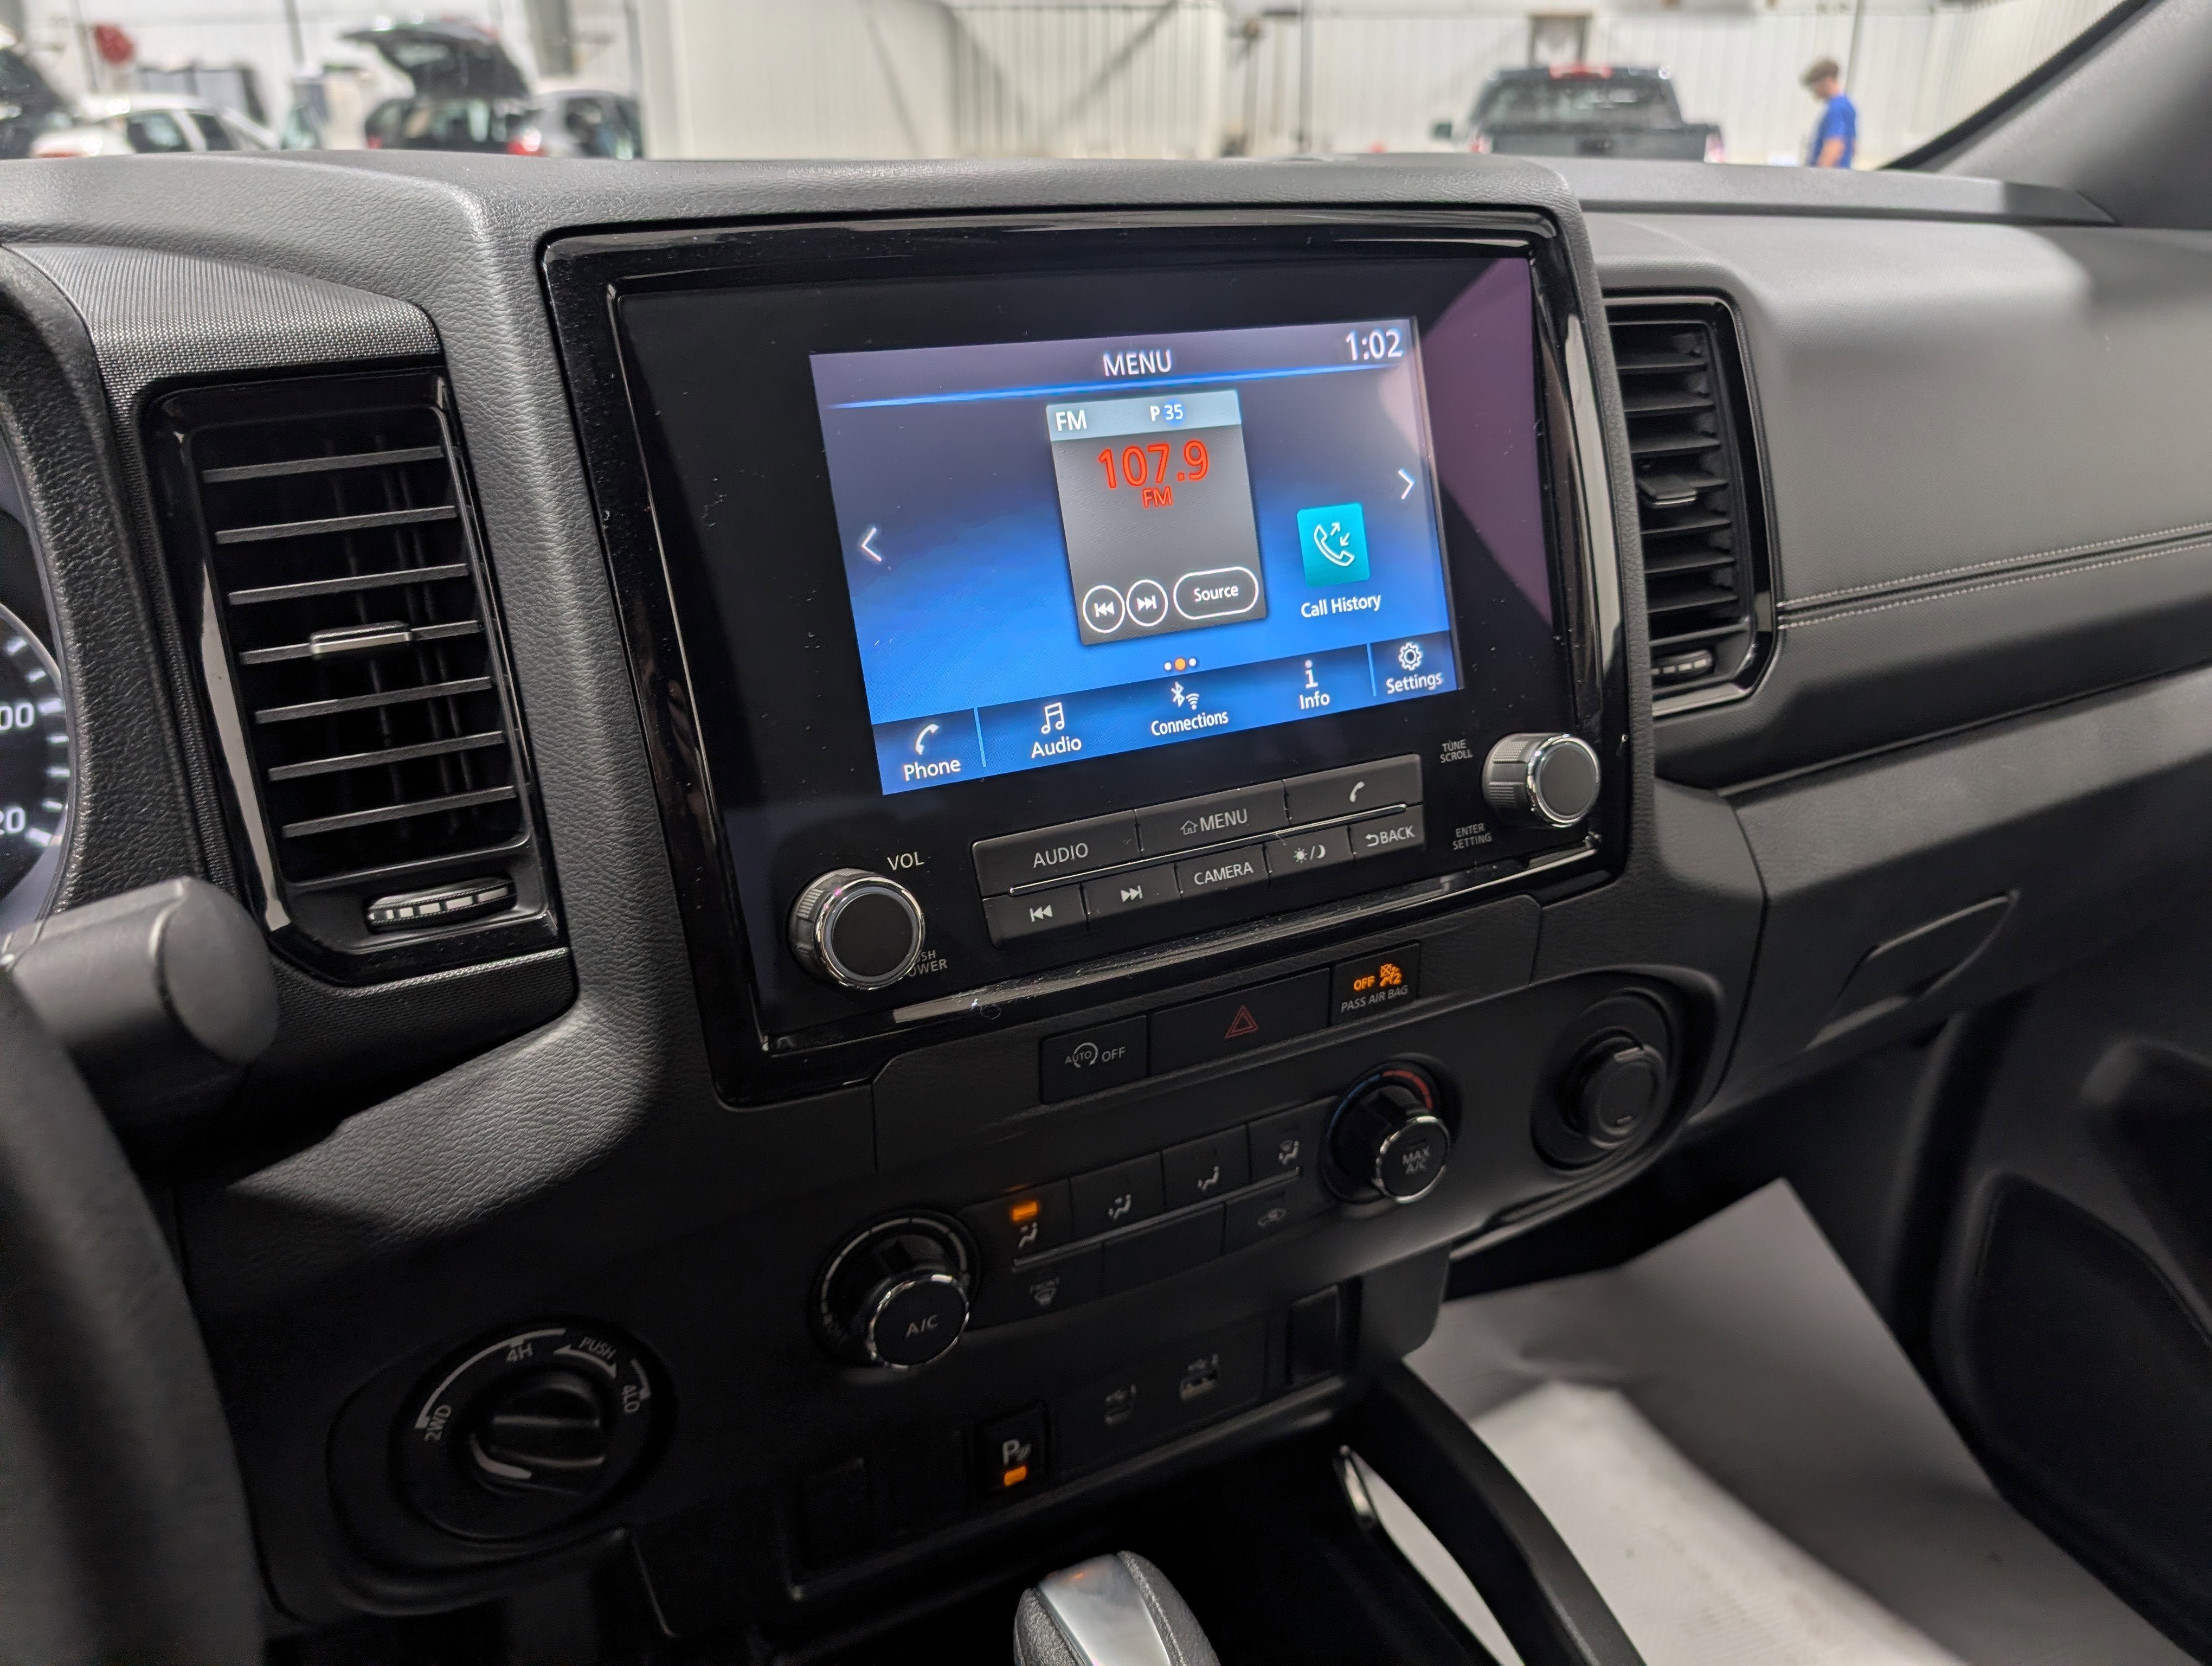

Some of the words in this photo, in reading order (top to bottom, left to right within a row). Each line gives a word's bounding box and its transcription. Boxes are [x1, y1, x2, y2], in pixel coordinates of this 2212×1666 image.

[1345, 329, 1404, 361] 1:02
[1102, 349, 1172, 377] MENU
[1056, 409, 1088, 432] FM
[1150, 405, 1160, 422] P
[1163, 403, 1184, 420] 35
[1098, 440, 1210, 489] 107.9
[1142, 486, 1173, 509] FM
[1193, 584, 1239, 603] Source
[1301, 600, 1329, 618] Call
[1332, 594, 1382, 617] History
[1386, 671, 1443, 695] Settings
[1300, 690, 1330, 710] Info
[1151, 710, 1229, 736] Connections
[1031, 735, 1082, 759] Audio
[1440, 749, 1473, 763] SCROLL
[1442, 739, 1466, 752] TUNE
[903, 759, 961, 781] Phone
[1199, 809, 1248, 832] MENU
[1456, 823, 1485, 838] ENTER
[1379, 825, 1415, 844] BACK
[1452, 832, 1492, 850] SETTING
[888, 851, 924, 871] VOL
[1033, 843, 1089, 868] AUDIO
[1194, 861, 1255, 885] CAMERA
[908, 958, 948, 977] OWER
[1354, 976, 1375, 991] OFF
[1341, 996, 1366, 1013] PASS
[1368, 991, 1386, 1004] AIR
[1387, 985, 1409, 999] BAG
[1065, 1050, 1092, 1064] AUTO
[1102, 1046, 1126, 1062] OFF
[1402, 1146, 1431, 1165] MAX
[905, 1314, 938, 1337] A/C
[506, 1343, 533, 1362] 4H
[579, 1336, 617, 1360] PUSH
[423, 1405, 452, 1441] 2WD
